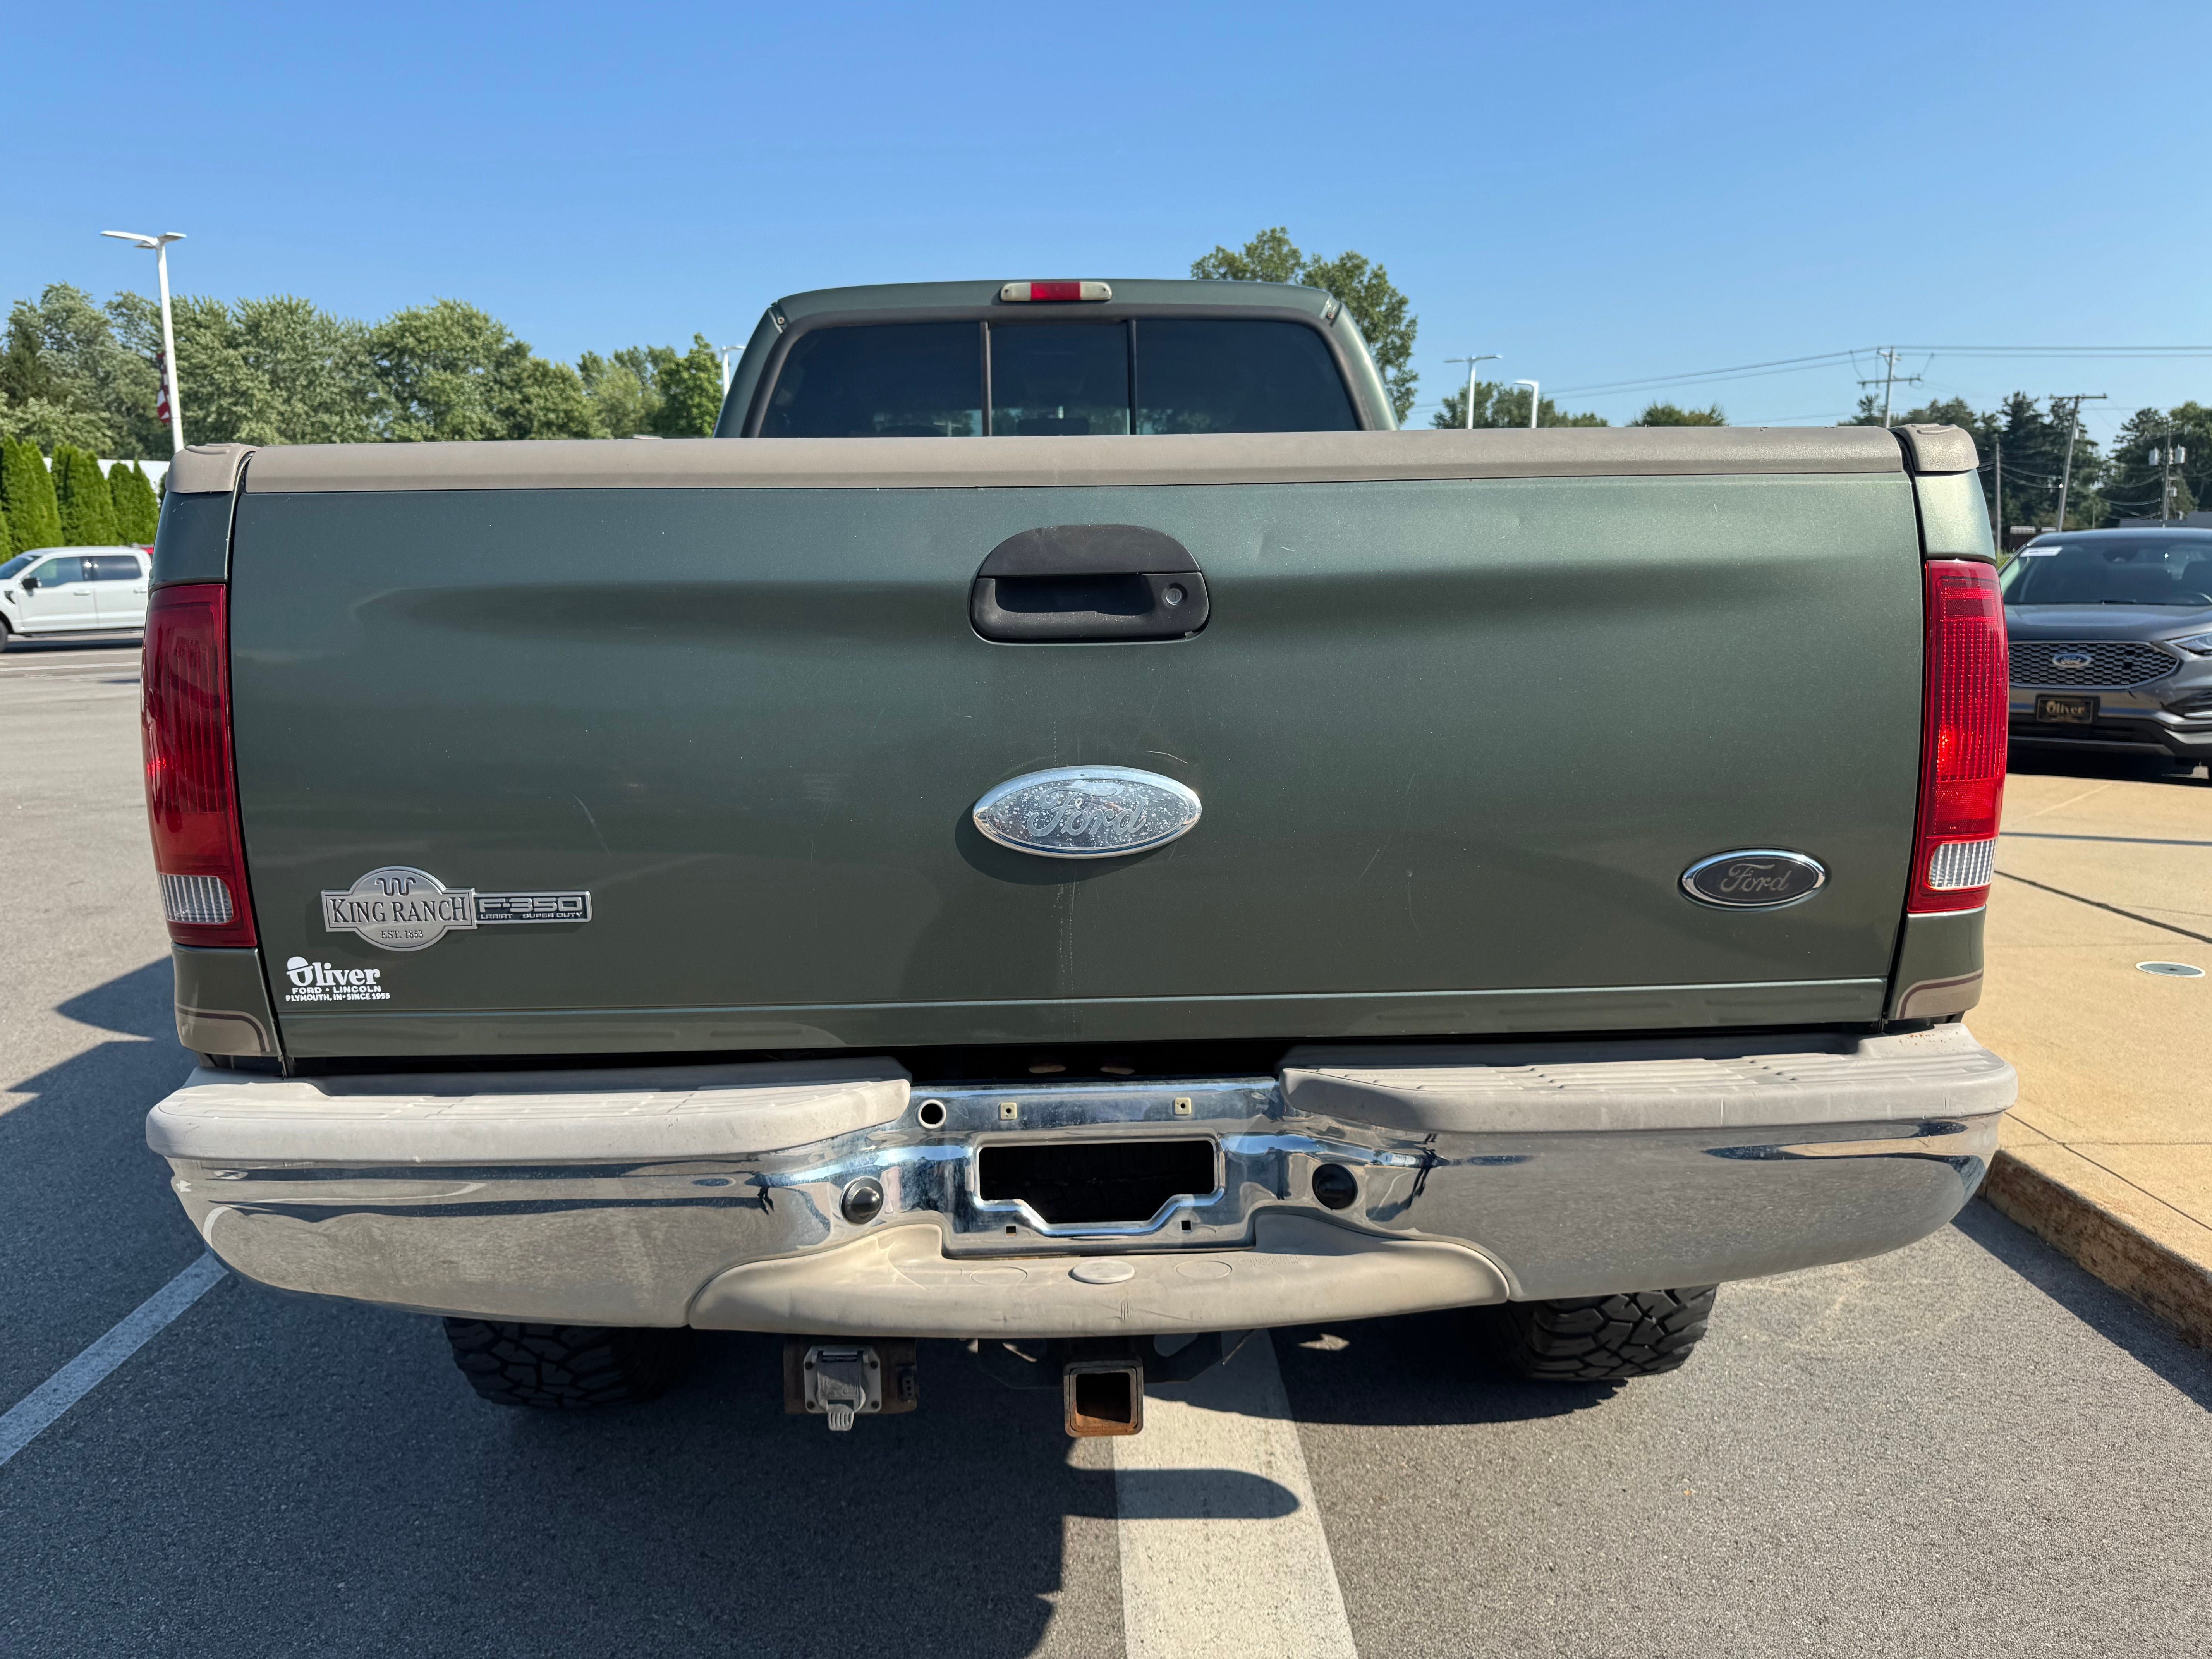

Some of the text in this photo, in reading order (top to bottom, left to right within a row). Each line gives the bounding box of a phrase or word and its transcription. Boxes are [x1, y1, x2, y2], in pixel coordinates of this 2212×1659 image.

[2046, 701, 2086, 715] Oliver
[1027, 780, 1149, 837] Ford
[1720, 863, 1792, 892] Ford
[330, 896, 468, 923] KING RANCH
[381, 930, 424, 939] EST. 1853
[286, 956, 380, 986] Oliver
[285, 994, 332, 1002] PLYMOUTH,
[333, 985, 381, 993] LINCOLN
